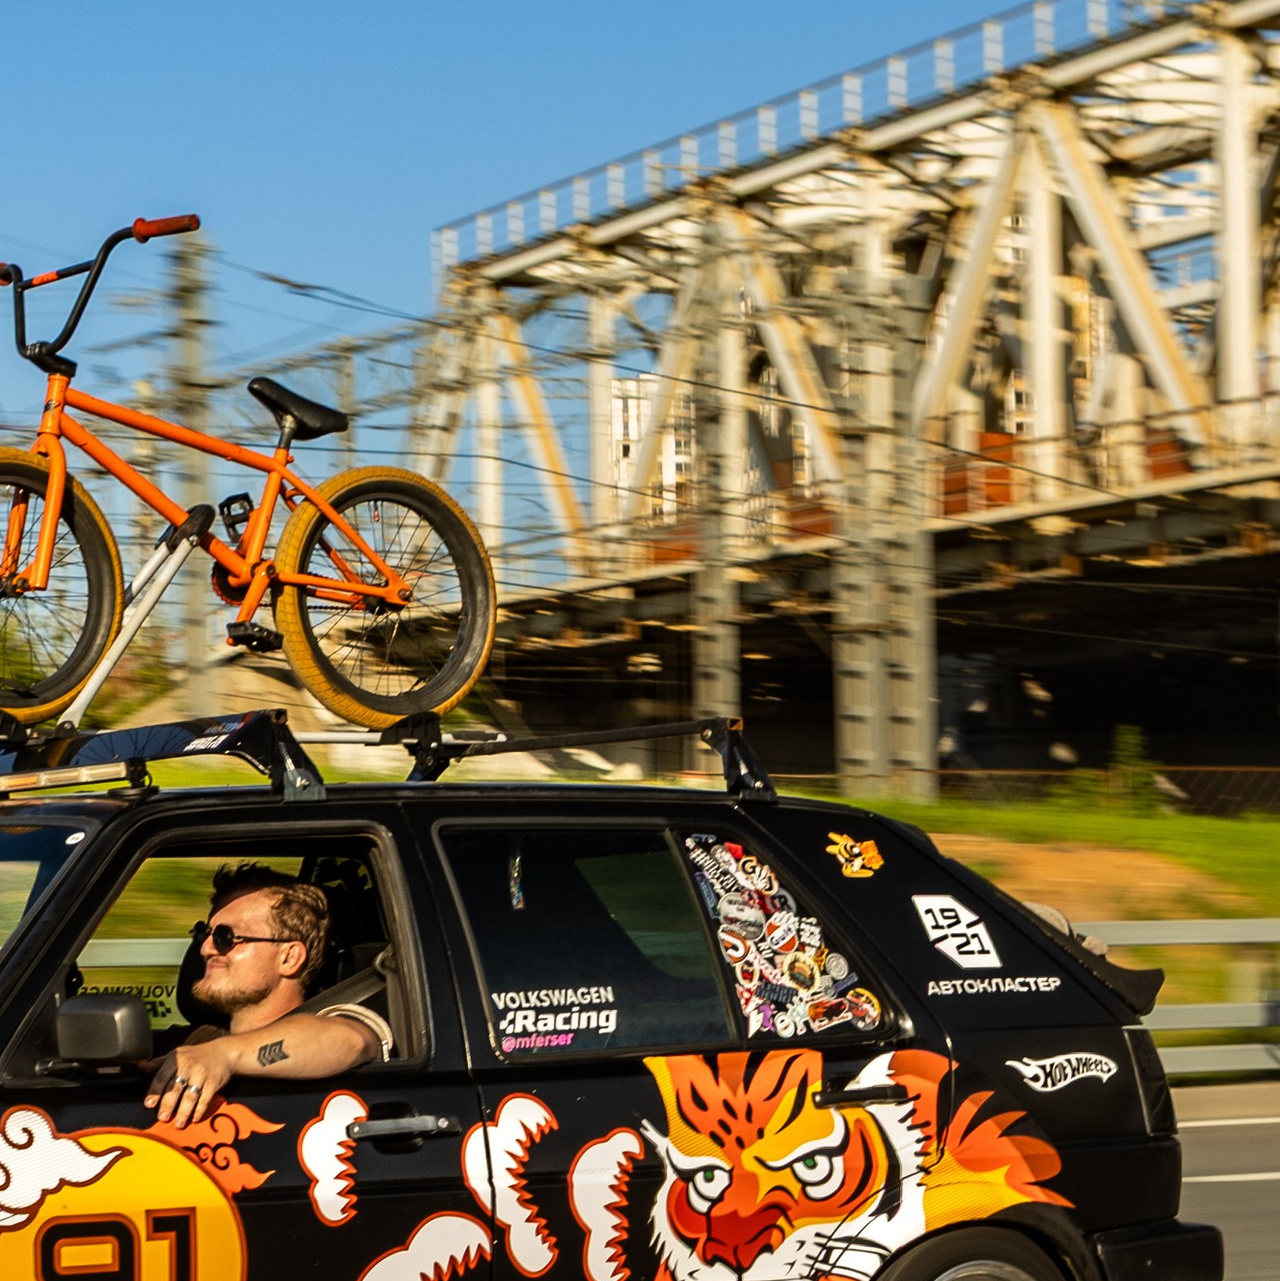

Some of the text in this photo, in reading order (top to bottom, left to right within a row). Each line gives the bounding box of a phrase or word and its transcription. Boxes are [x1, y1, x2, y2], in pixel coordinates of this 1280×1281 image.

[927, 976, 1062, 996] АВТОКЛАСТЕР
[491, 986, 615, 1010] VOLKSWAGEN
[514, 1006, 618, 1034] Racing
[501, 1032, 575, 1053] @mferser
